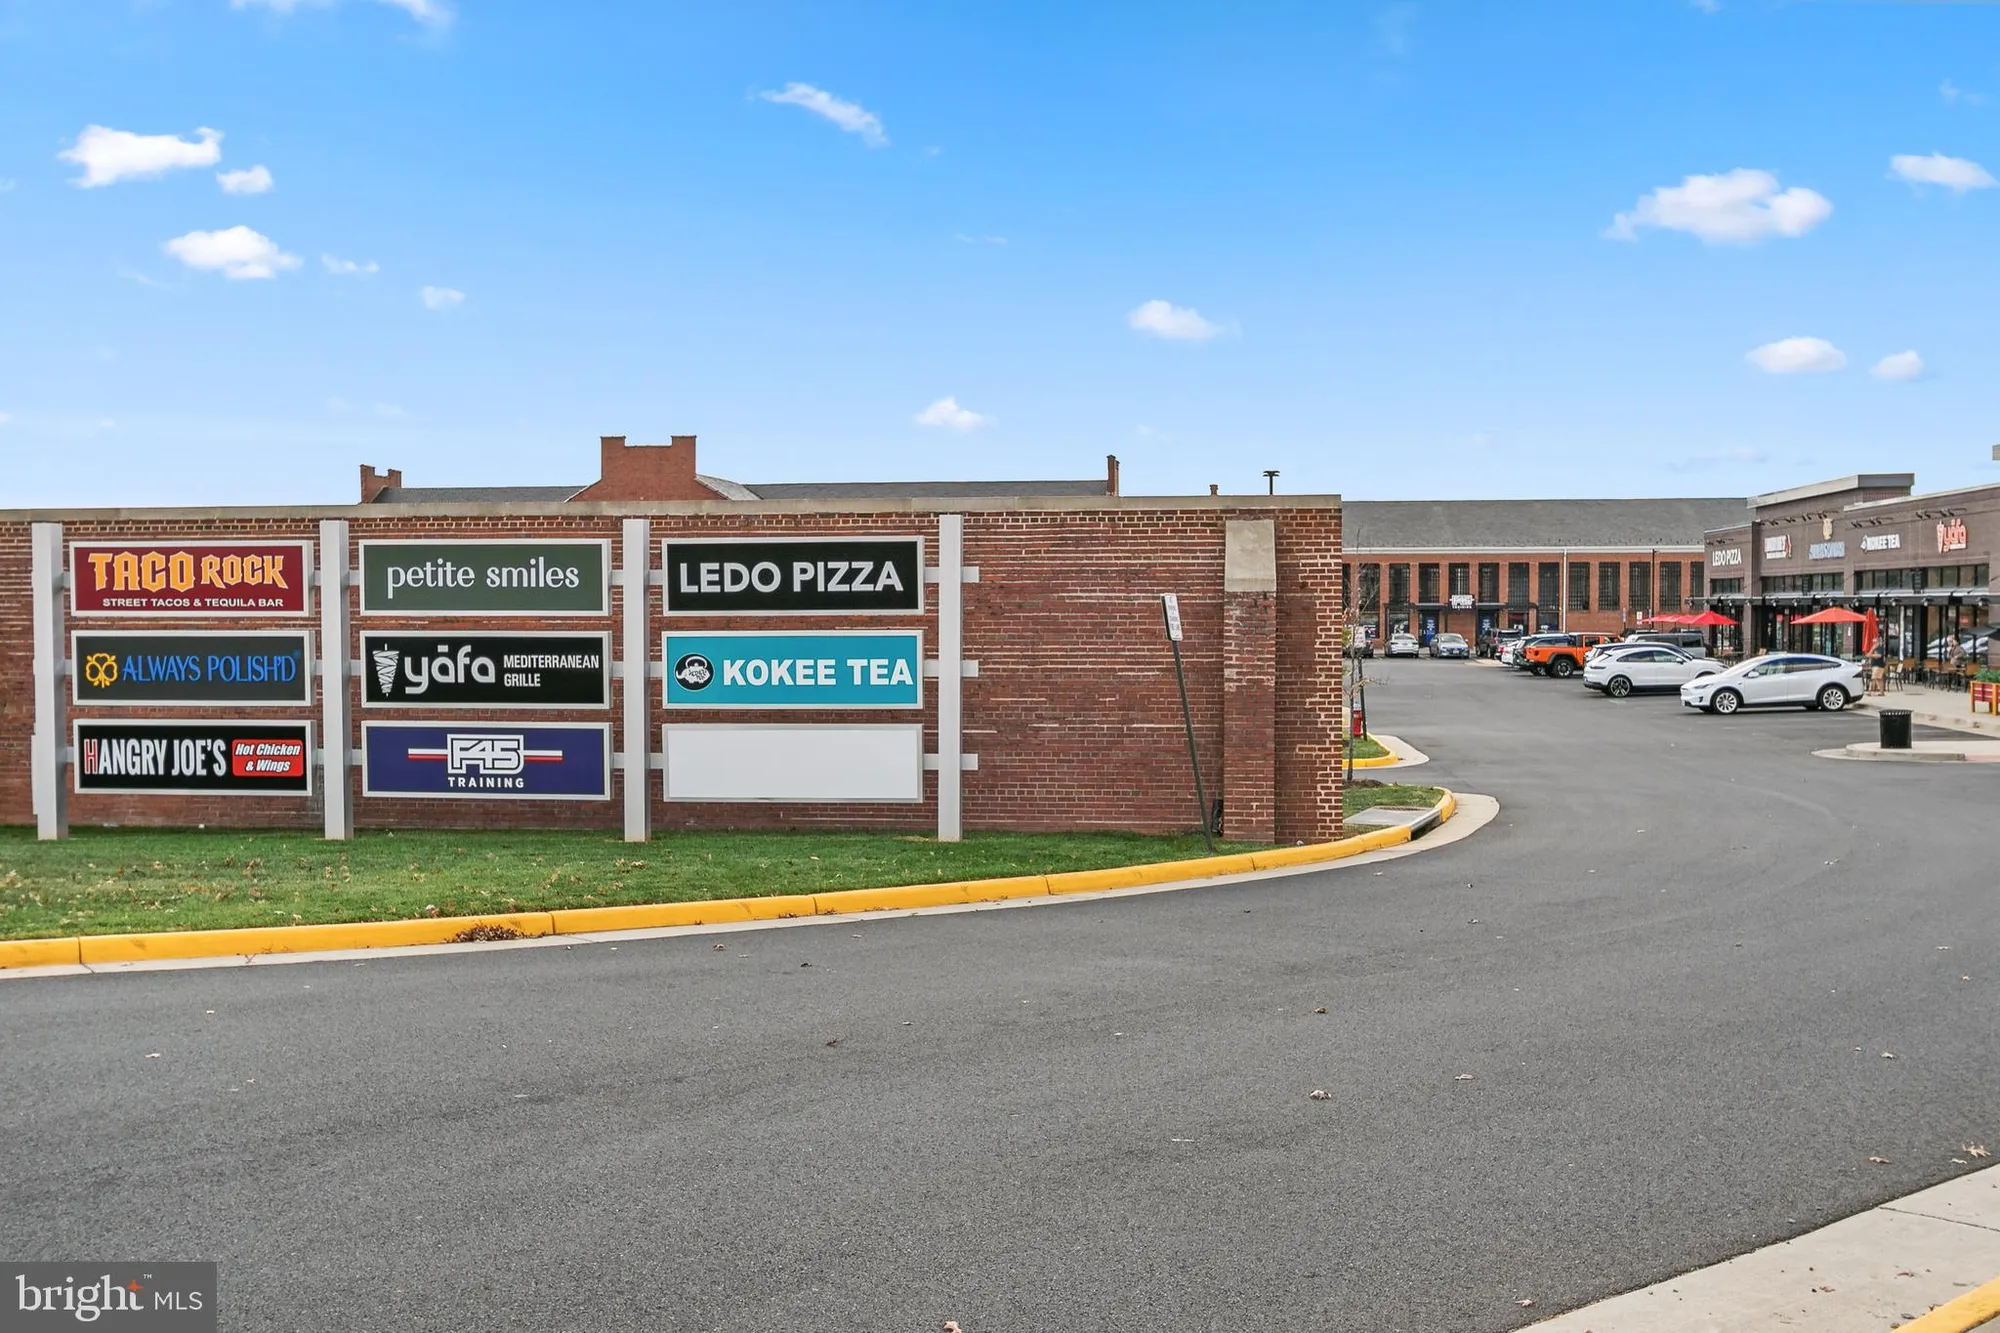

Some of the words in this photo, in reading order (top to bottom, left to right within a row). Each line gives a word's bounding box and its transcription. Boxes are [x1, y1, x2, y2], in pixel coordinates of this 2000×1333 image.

[88, 551, 195, 592] TACO
[201, 554, 289, 589] ROCK
[387, 557, 476, 599] petite
[486, 556, 580, 588] smiles
[680, 561, 781, 594] LEDO
[793, 561, 904, 592] PIZZA
[102, 598, 147, 607] STREET
[150, 598, 190, 607] TACOS
[193, 598, 202, 607] &
[204, 598, 256, 607] TEQUILA
[258, 598, 284, 607] BAR
[122, 655, 201, 682] ALWAYS
[503, 654, 600, 669] MEDITERRANEAN
[723, 659, 837, 686] KOKEE
[846, 658, 914, 685] TEA
[504, 673, 541, 687] GRILLE
[83, 738, 167, 776] HANGRY
[171, 738, 227, 777] JOE'S
[235, 743, 254, 756] Hot
[256, 743, 301, 756] Chicken
[450, 738, 522, 771] F45
[245, 760, 254, 772] &
[256, 759, 291, 773] Wings
[448, 777, 524, 789] TRAINING
